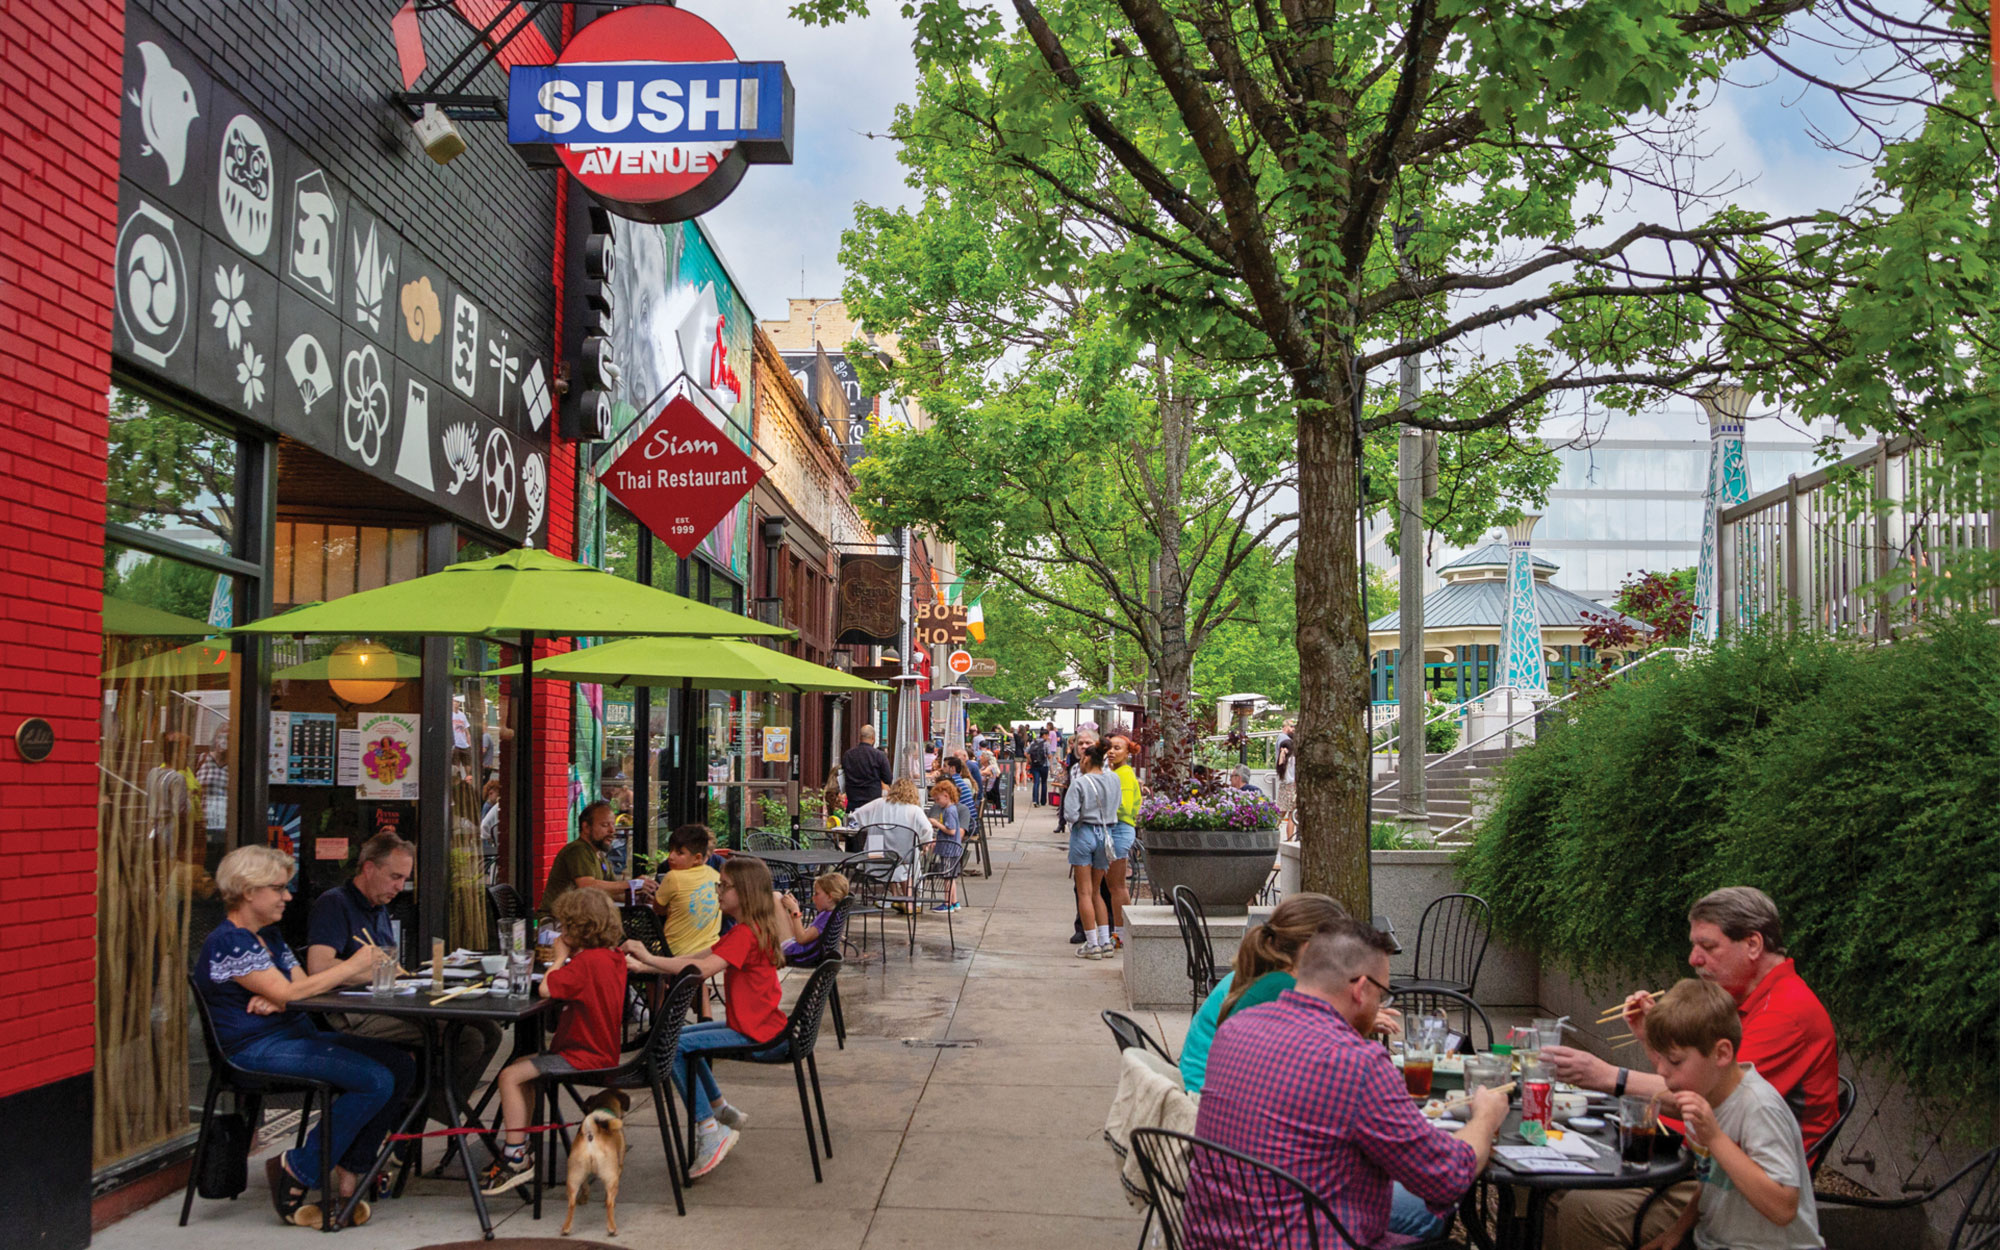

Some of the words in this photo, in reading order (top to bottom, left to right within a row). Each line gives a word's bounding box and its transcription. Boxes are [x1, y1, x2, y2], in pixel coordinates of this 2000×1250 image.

[534, 78, 759, 134] SUSHI
[578, 149, 709, 175] AVENUE
[643, 429, 718, 460] Siam
[617, 470, 651, 490] Thai
[657, 466, 748, 488] Restaurant
[671, 525, 695, 535] 1999
[918, 603, 950, 620] BO
[916, 627, 949, 644] HO
